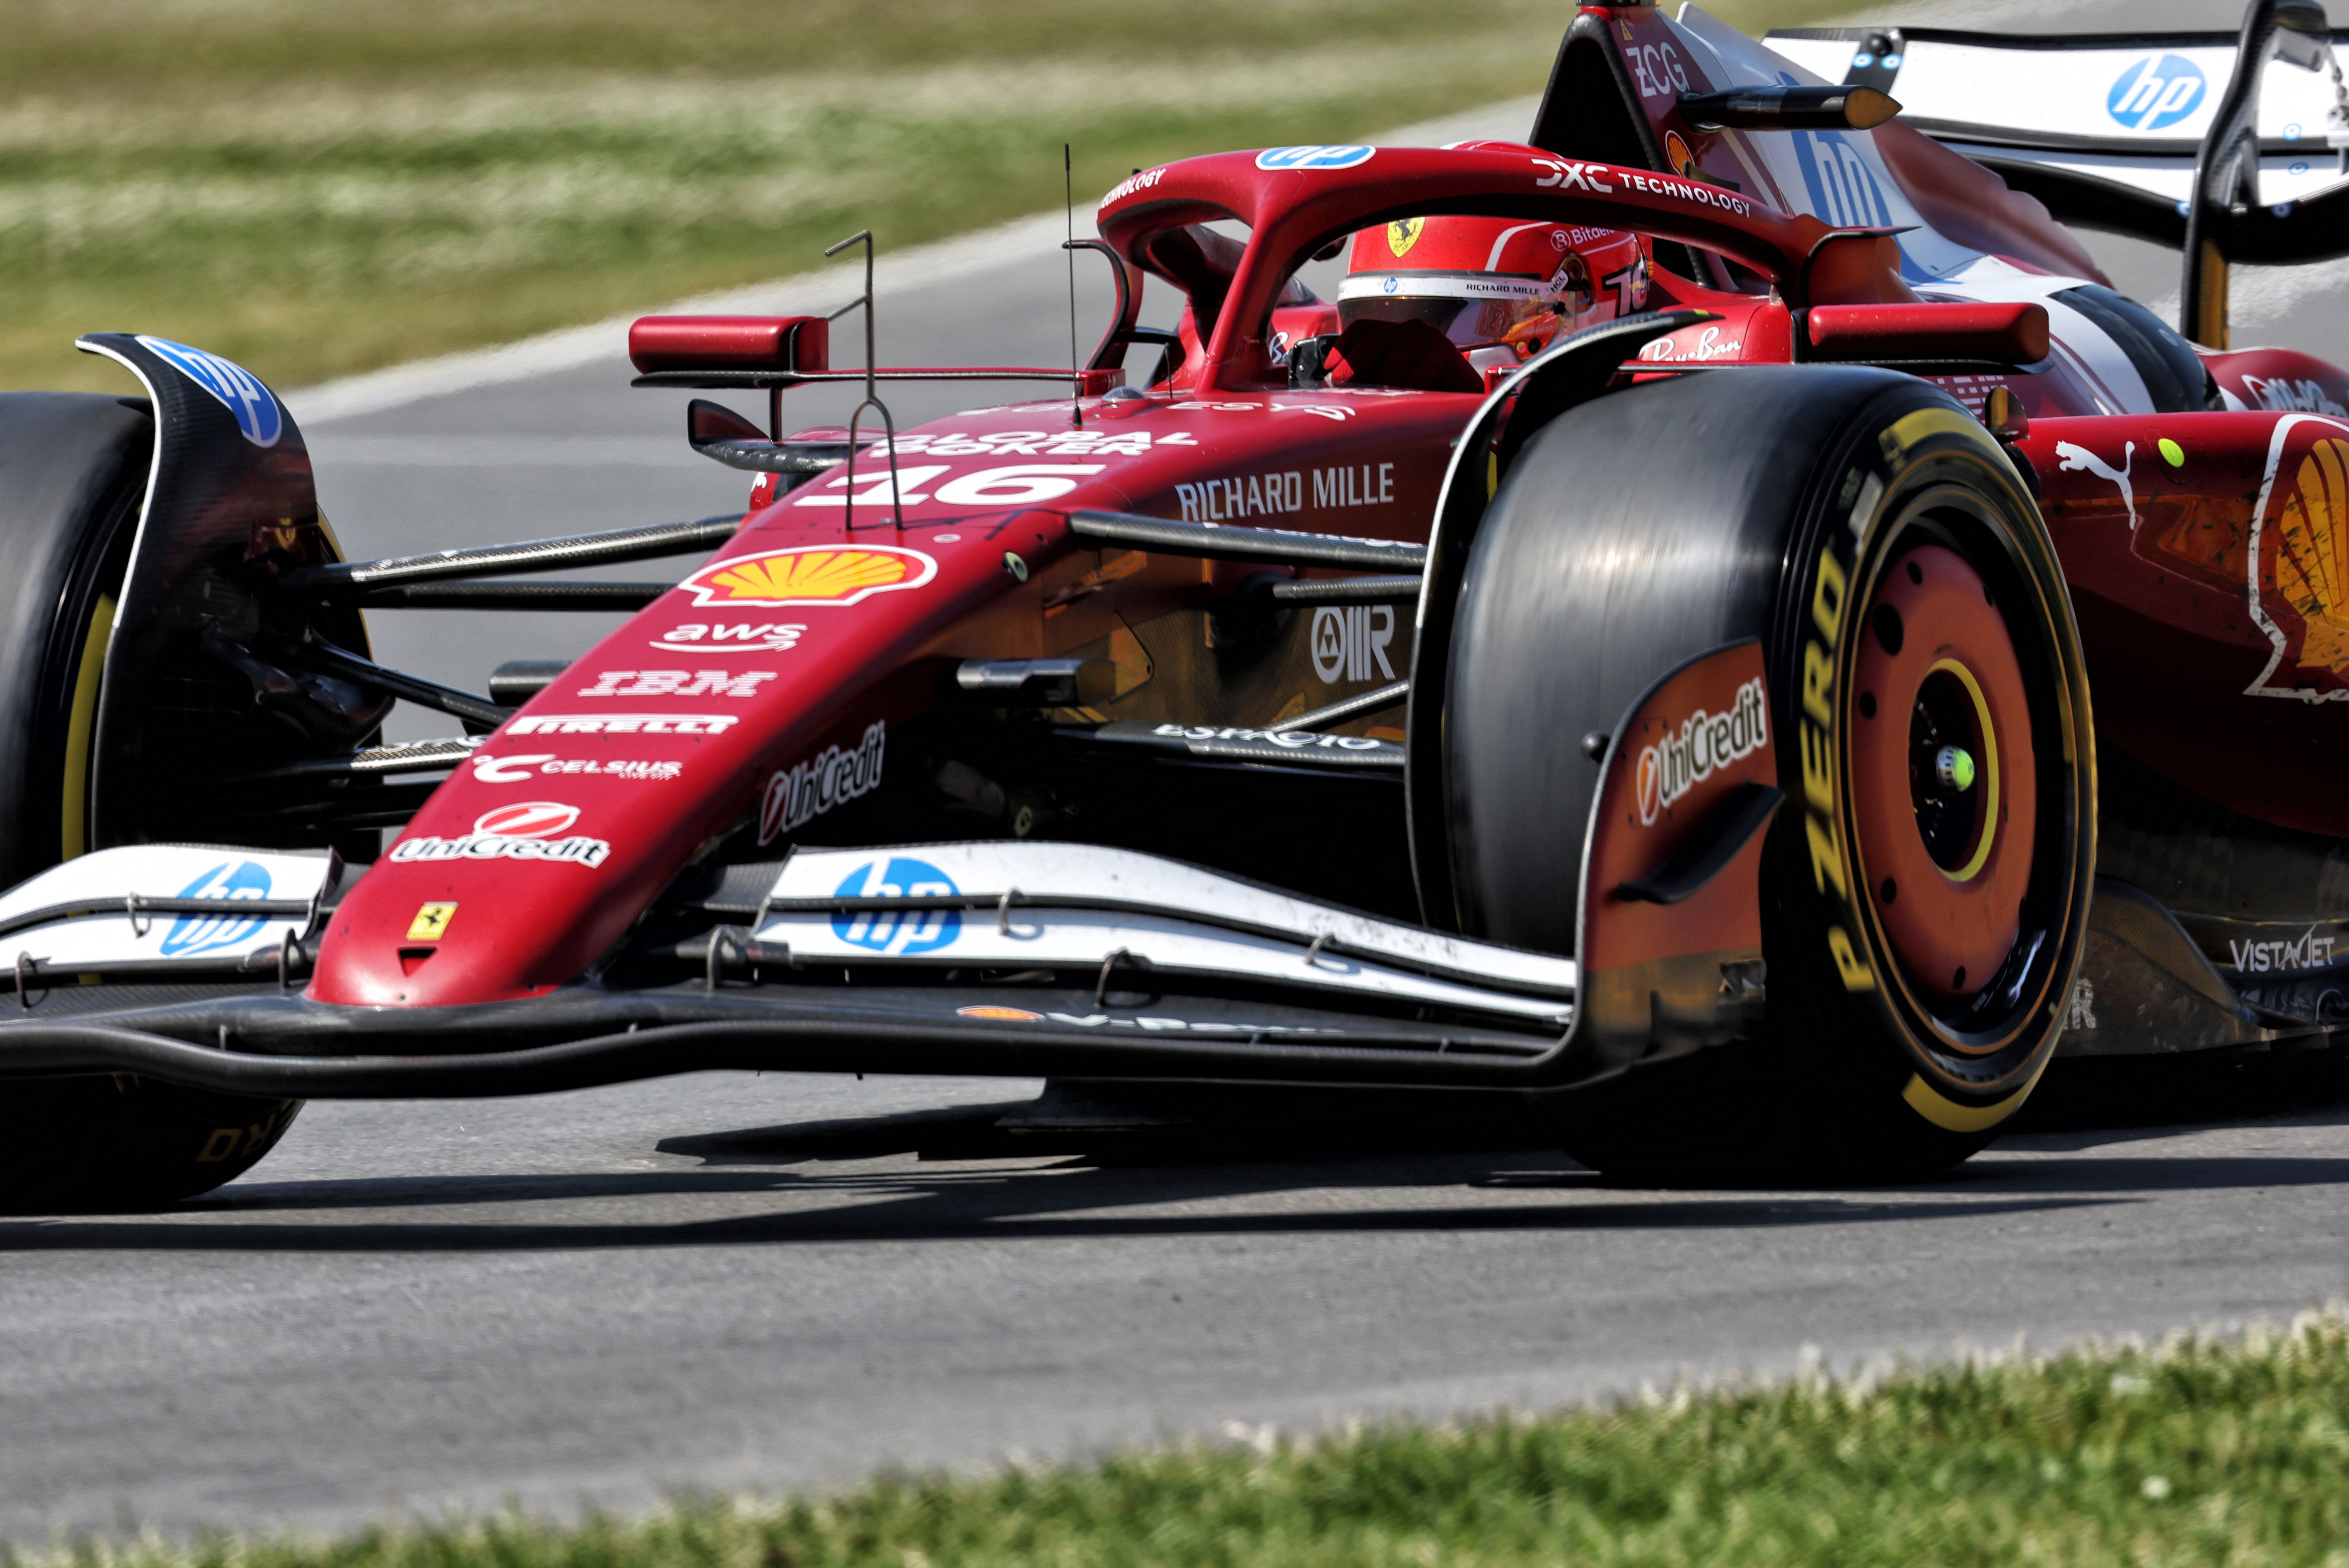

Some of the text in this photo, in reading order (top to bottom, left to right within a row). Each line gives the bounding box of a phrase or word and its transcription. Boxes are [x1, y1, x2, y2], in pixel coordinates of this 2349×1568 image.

[2111, 54, 2204, 130] hp
[1265, 145, 1355, 169] hp
[1532, 158, 1750, 218] DXC TECHNOLOGY
[1384, 277, 1398, 294] hp
[1466, 283, 1540, 296] RICHARD MILLE
[868, 442, 1153, 458] POKER
[873, 430, 1199, 446] GLOBAL
[794, 465, 1107, 506] 16
[1175, 462, 1394, 521] RICHARD MILLE
[664, 623, 808, 642] aws
[578, 670, 778, 697] IBM
[505, 713, 739, 735] PIRELLI
[1659, 677, 1766, 808] UniCredit
[540, 760, 684, 777] CELSIUS
[783, 720, 886, 832] UniCredit
[1799, 546, 1876, 993] P ZERO
[393, 836, 609, 864] UniCredit
[844, 859, 952, 955] hp
[2229, 923, 2335, 972] VISTAJET
